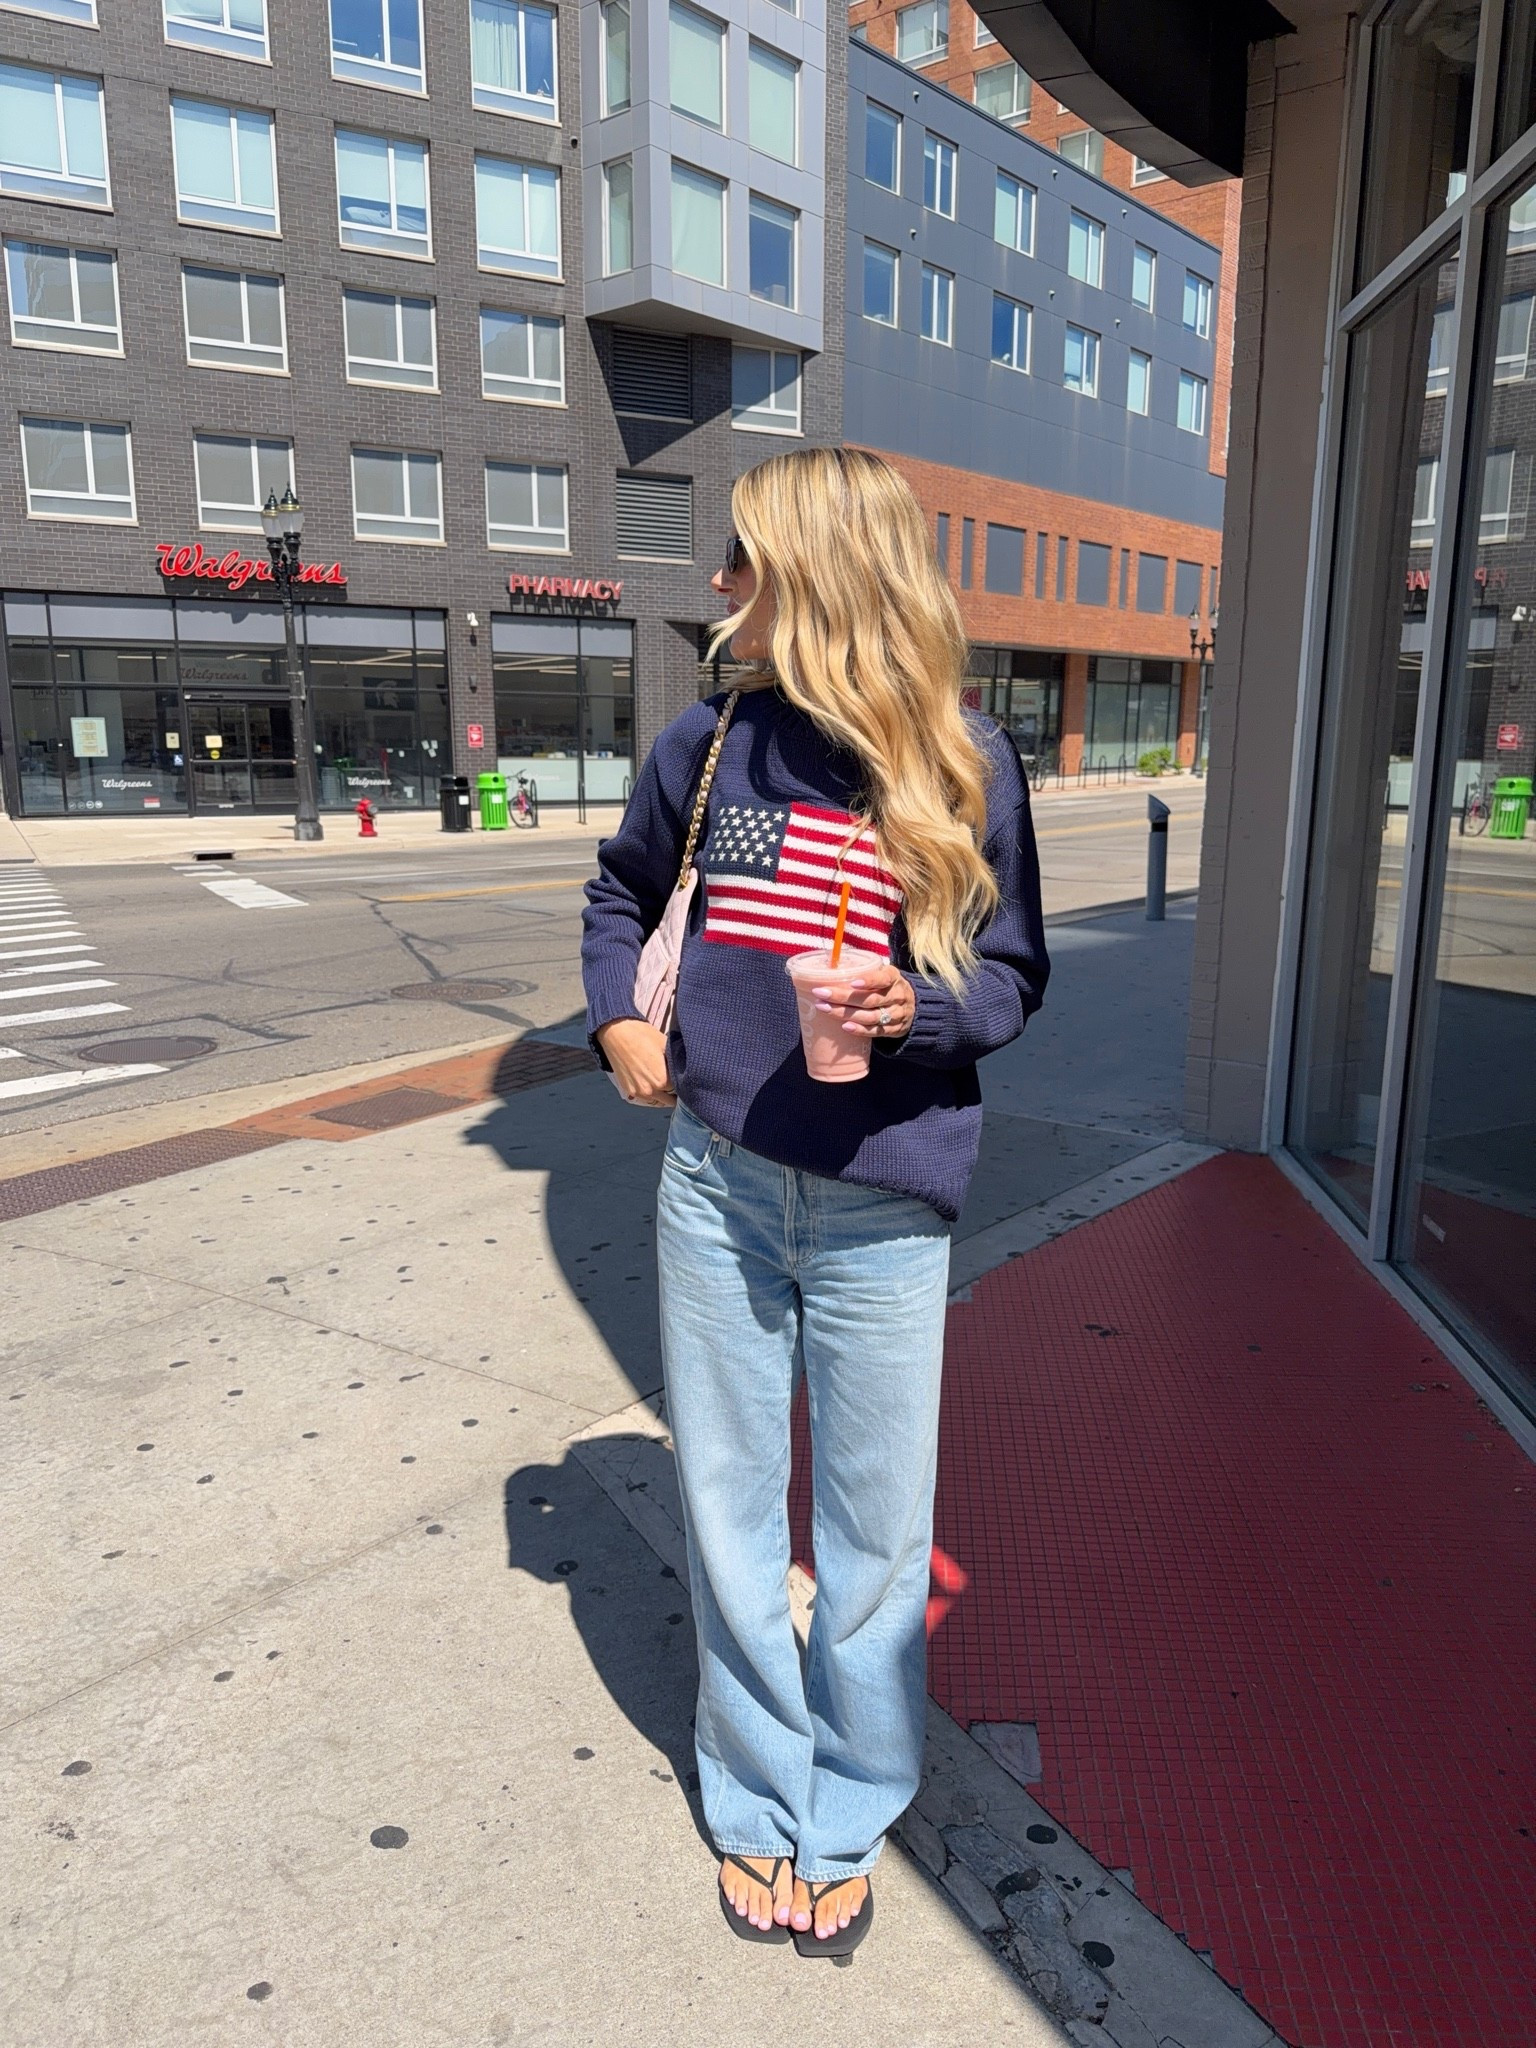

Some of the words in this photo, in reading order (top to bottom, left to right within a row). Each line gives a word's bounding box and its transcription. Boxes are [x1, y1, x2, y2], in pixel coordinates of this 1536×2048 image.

[156, 543, 348, 591] Walgrns
[509, 574, 623, 600] PHARMACY
[102, 779, 153, 791] Walgreens
[347, 776, 392, 788] Walgreens
